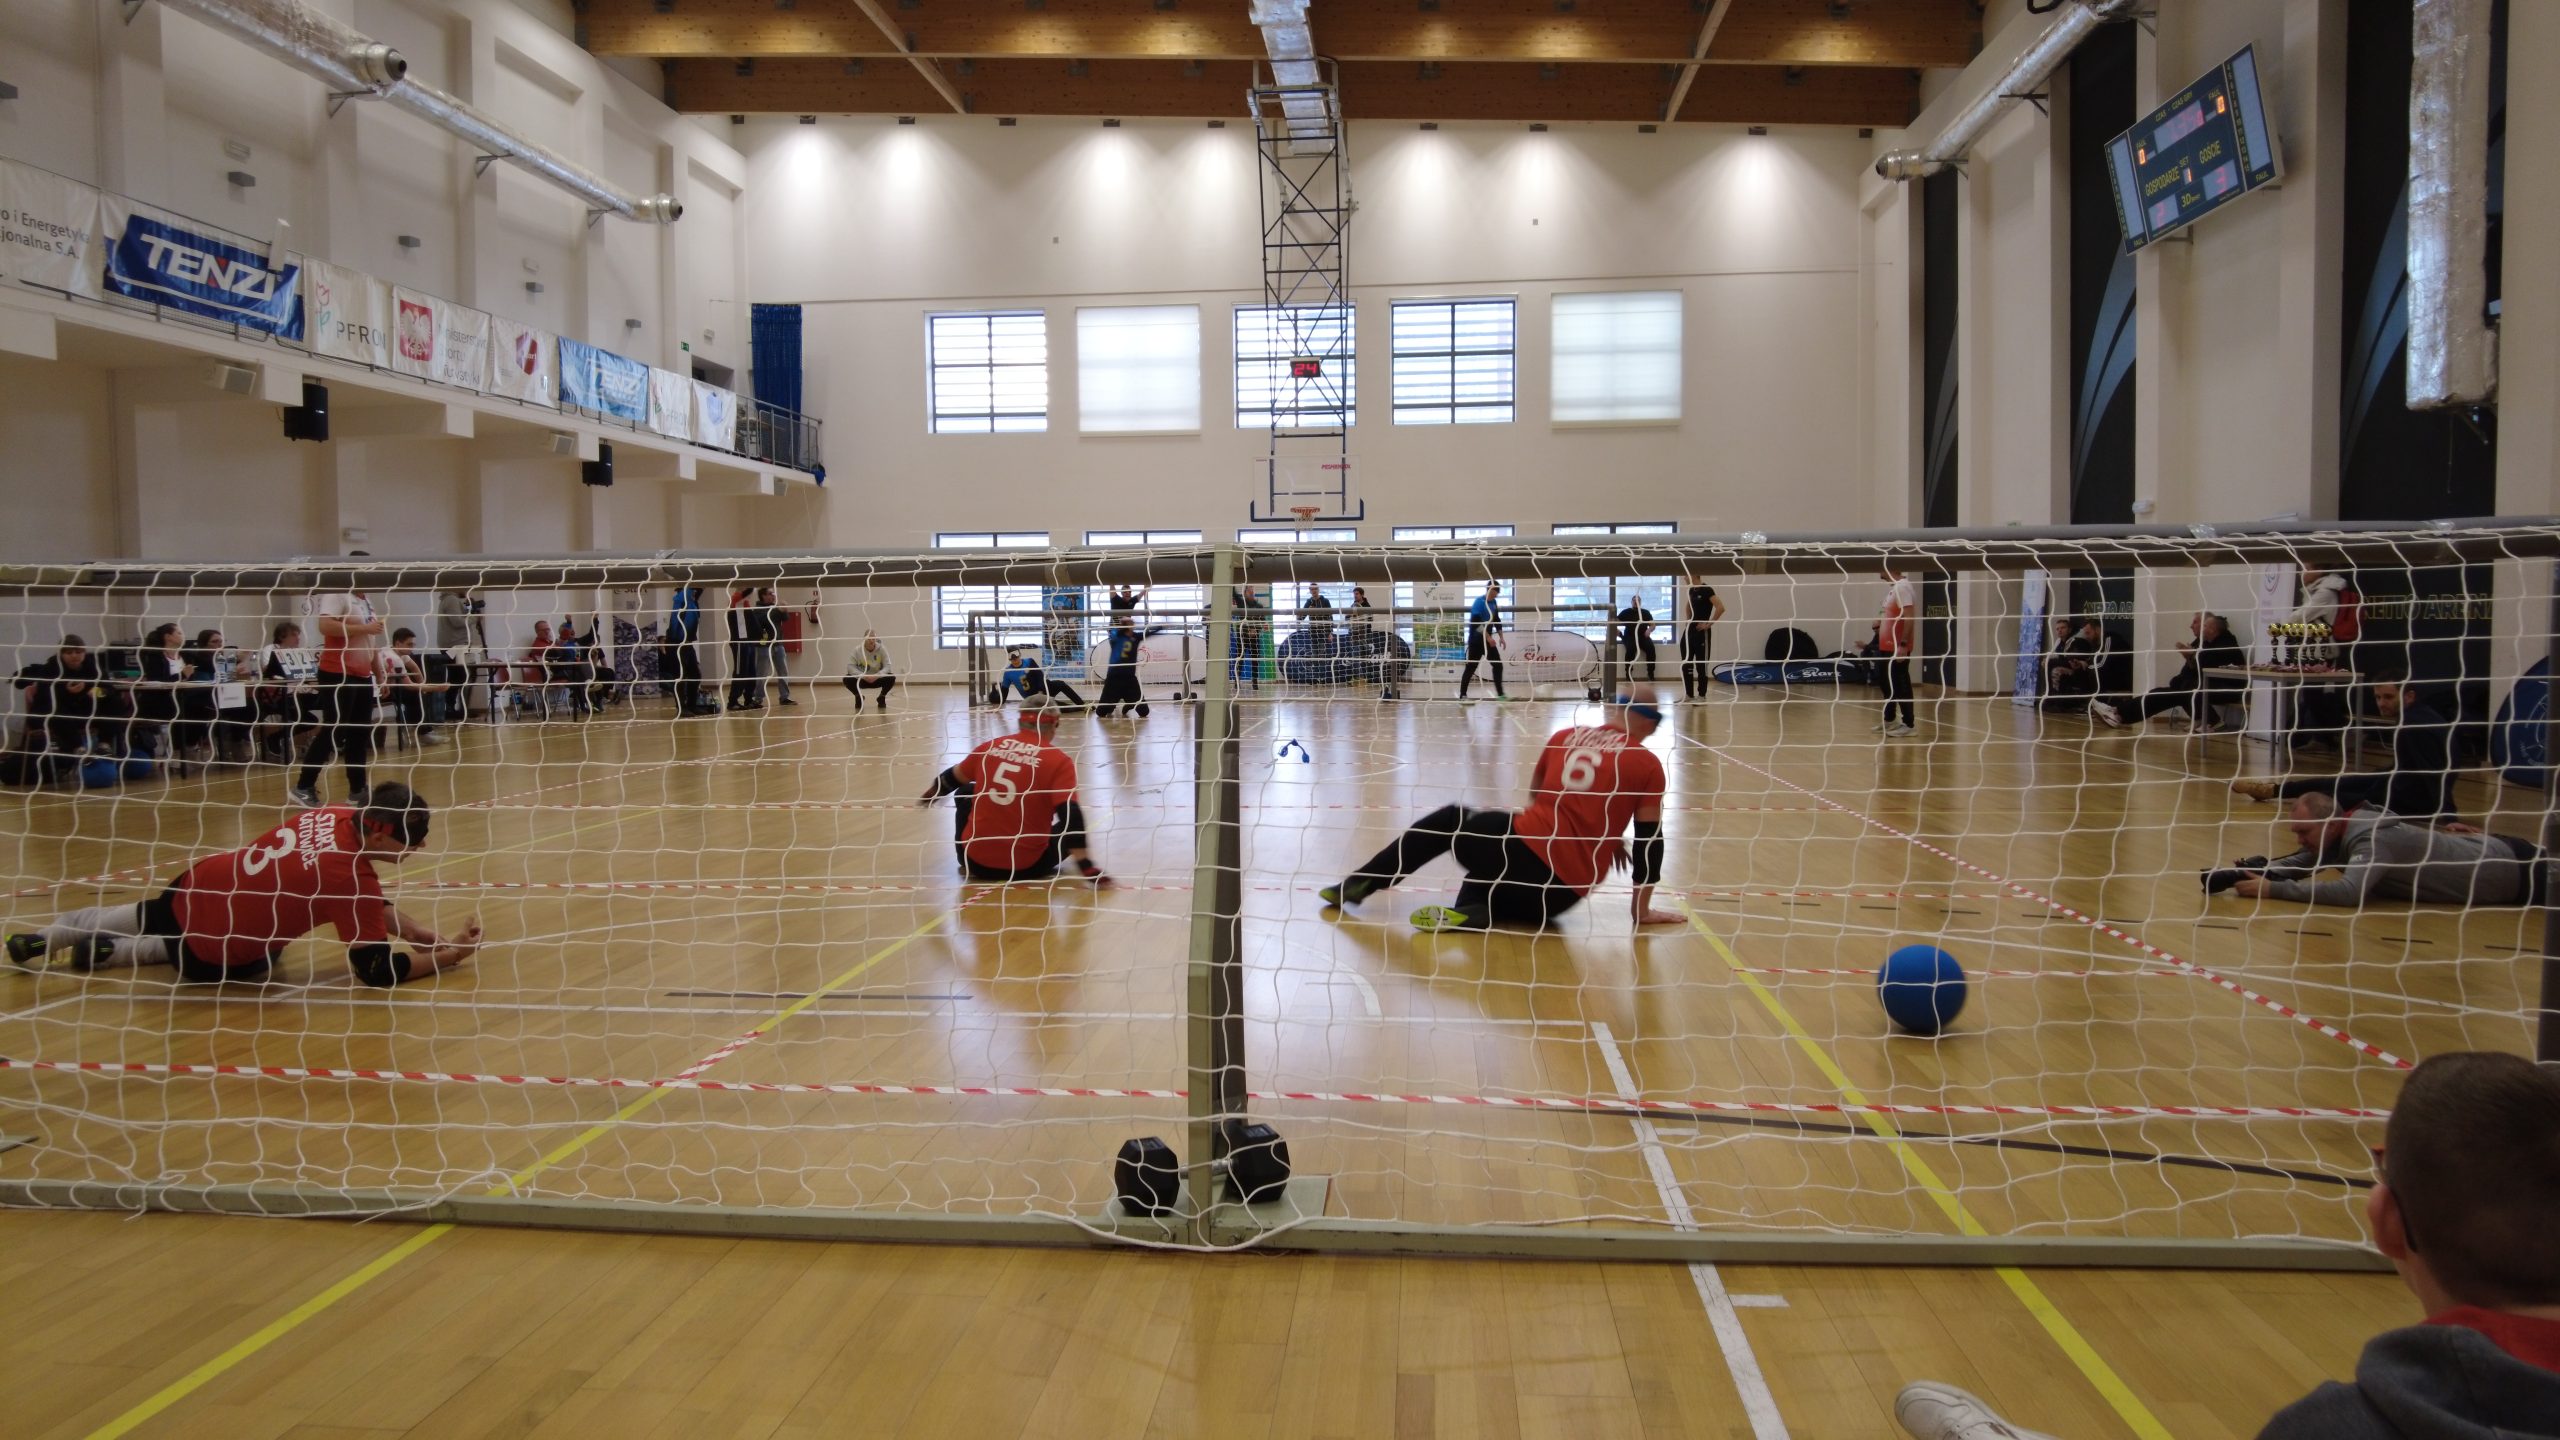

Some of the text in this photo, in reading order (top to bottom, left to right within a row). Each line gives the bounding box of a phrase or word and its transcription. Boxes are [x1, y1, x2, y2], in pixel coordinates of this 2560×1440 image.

[14, 210, 17, 222] i
[56, 241, 80, 259] S.A.
[140, 233, 276, 301] TENZI
[337, 321, 386, 351] PFRON
[1294, 363, 1317, 375] 24
[989, 762, 1021, 806] 5
[1561, 748, 1602, 790] 6
[243, 827, 297, 876] 3
